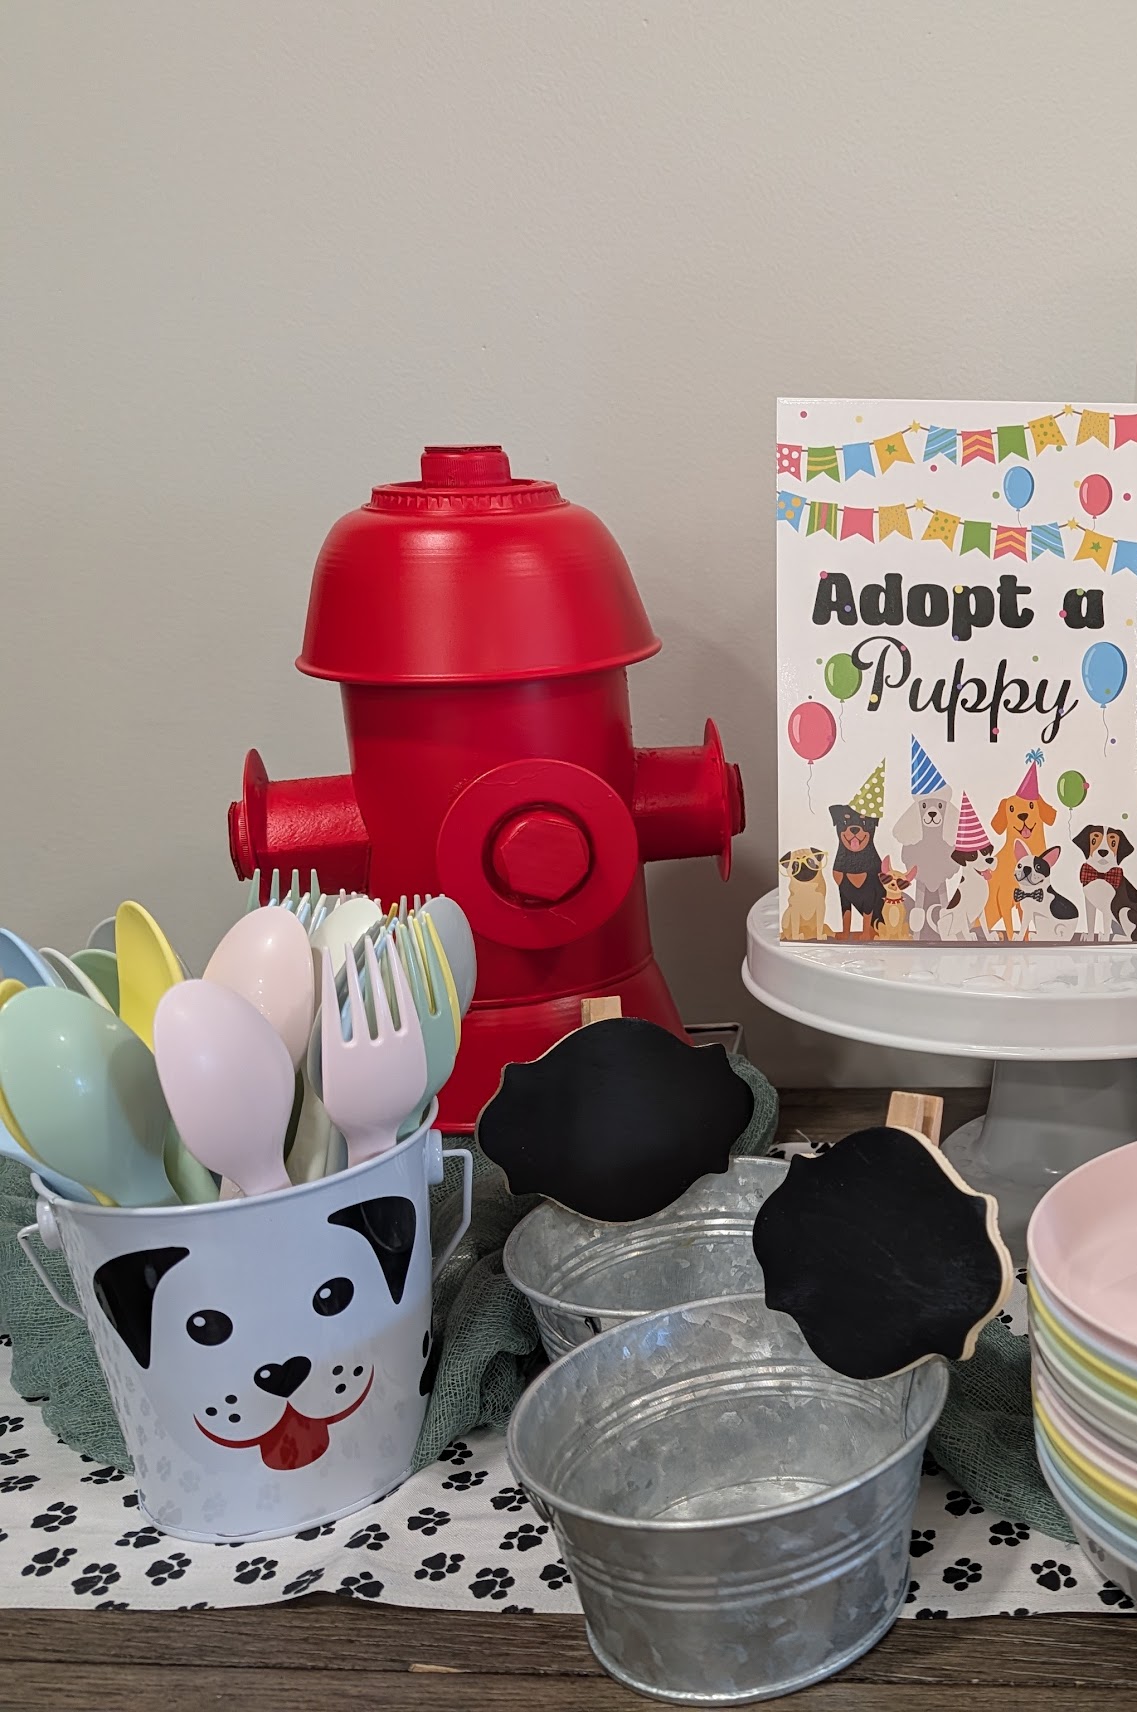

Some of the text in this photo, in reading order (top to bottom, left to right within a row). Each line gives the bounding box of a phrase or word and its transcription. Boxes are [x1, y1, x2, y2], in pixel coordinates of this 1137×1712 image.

[812, 572, 1105, 641] Adopt a
[851, 636, 1079, 744] Puppy
